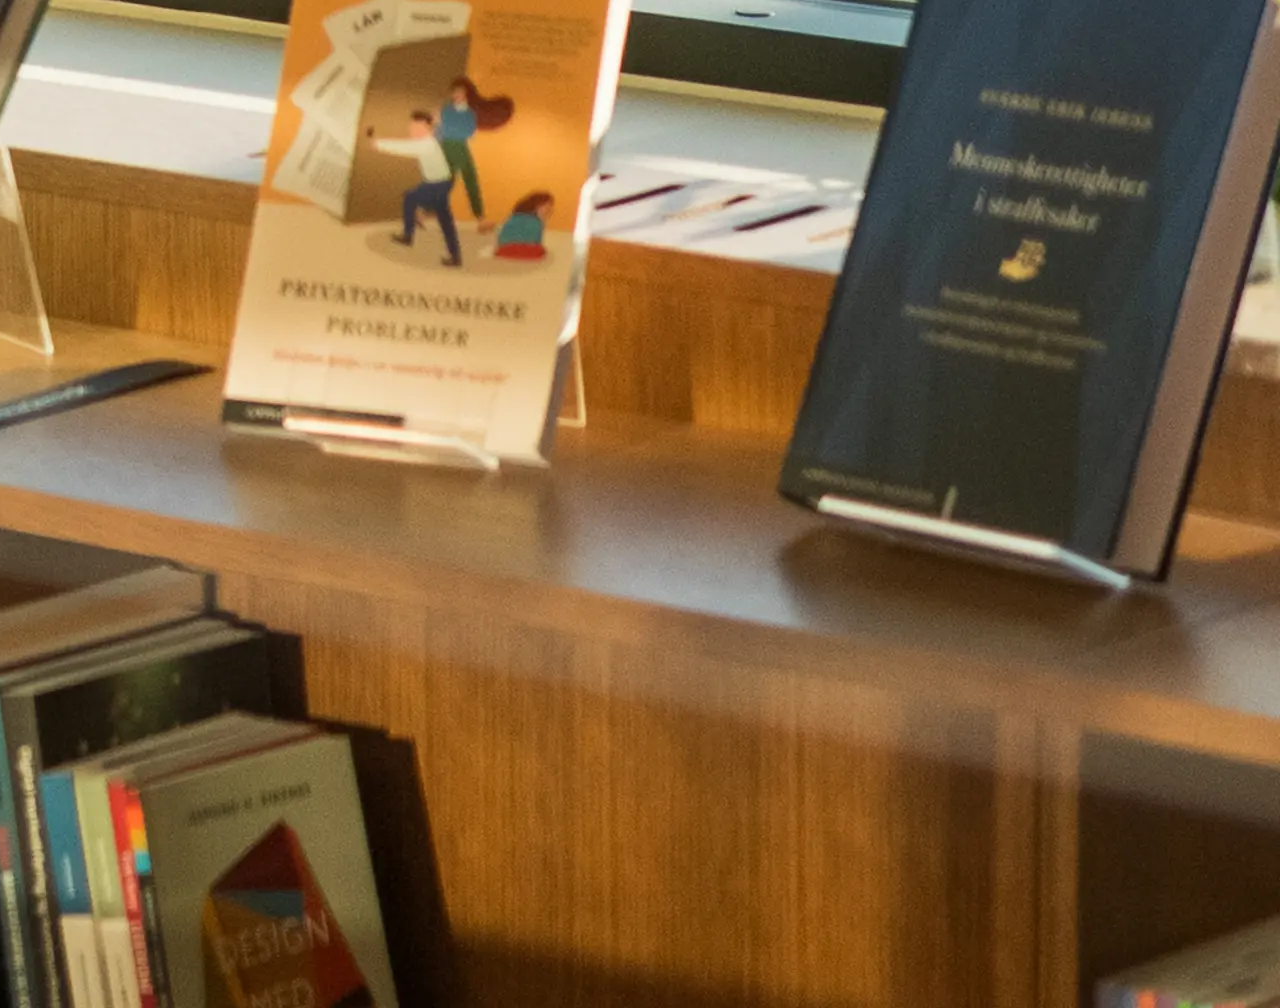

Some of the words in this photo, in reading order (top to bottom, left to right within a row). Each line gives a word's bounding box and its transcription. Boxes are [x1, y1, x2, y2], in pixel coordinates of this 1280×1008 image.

[972, 186, 988, 216] i
[278, 277, 528, 321] PRIVATØKONOMISKE
[326, 314, 470, 347] PROBLEMER
